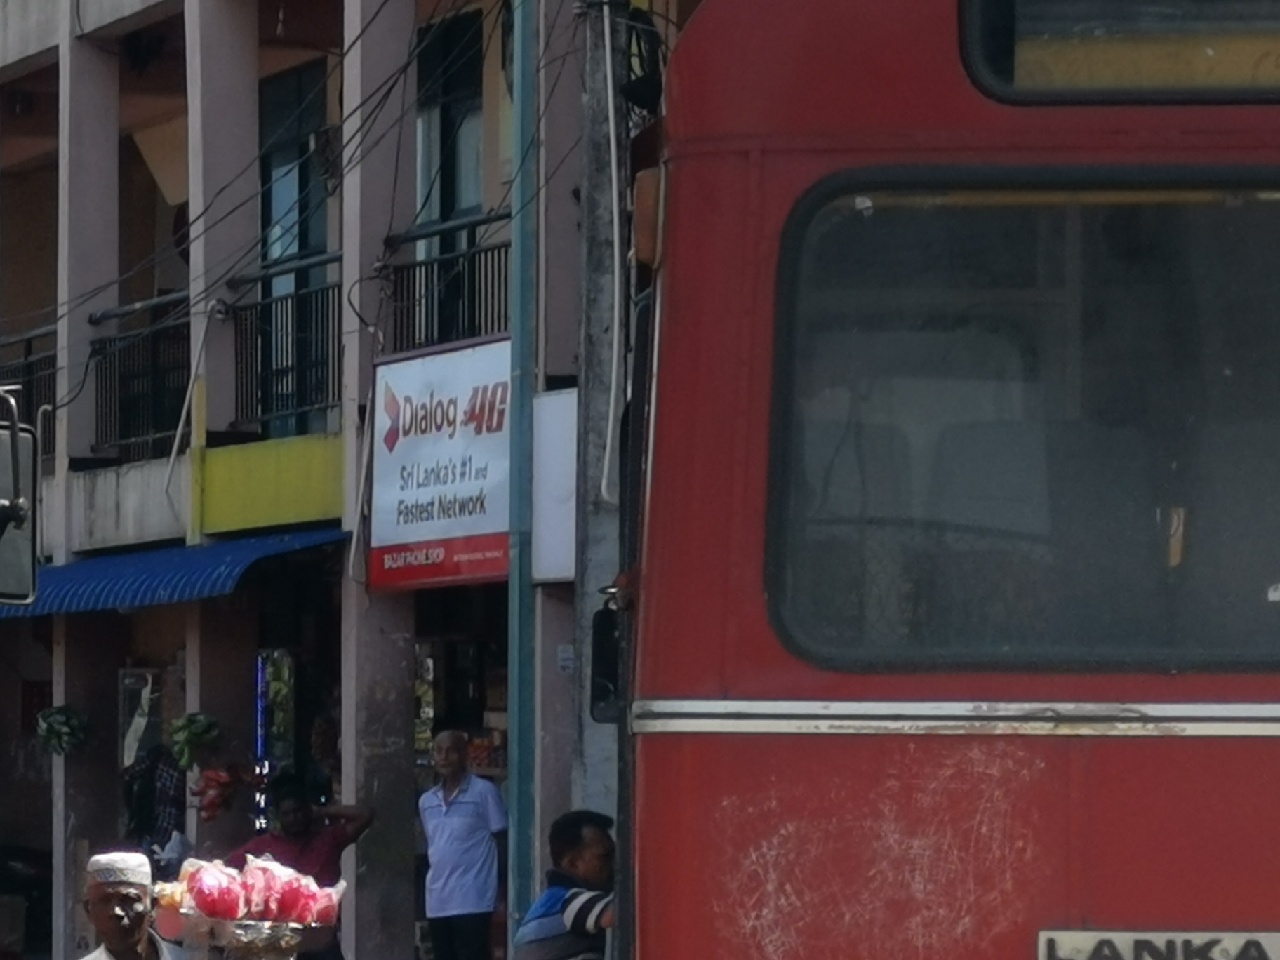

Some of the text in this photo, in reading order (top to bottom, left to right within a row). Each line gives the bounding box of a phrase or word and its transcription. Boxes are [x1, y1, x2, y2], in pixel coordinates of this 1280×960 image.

[401, 379, 510, 440] Dialog 4G
[399, 463, 414, 492] Sri
[416, 456, 457, 491] Lanka's
[459, 453, 473, 484] #1
[395, 486, 487, 527] Fastest Network
